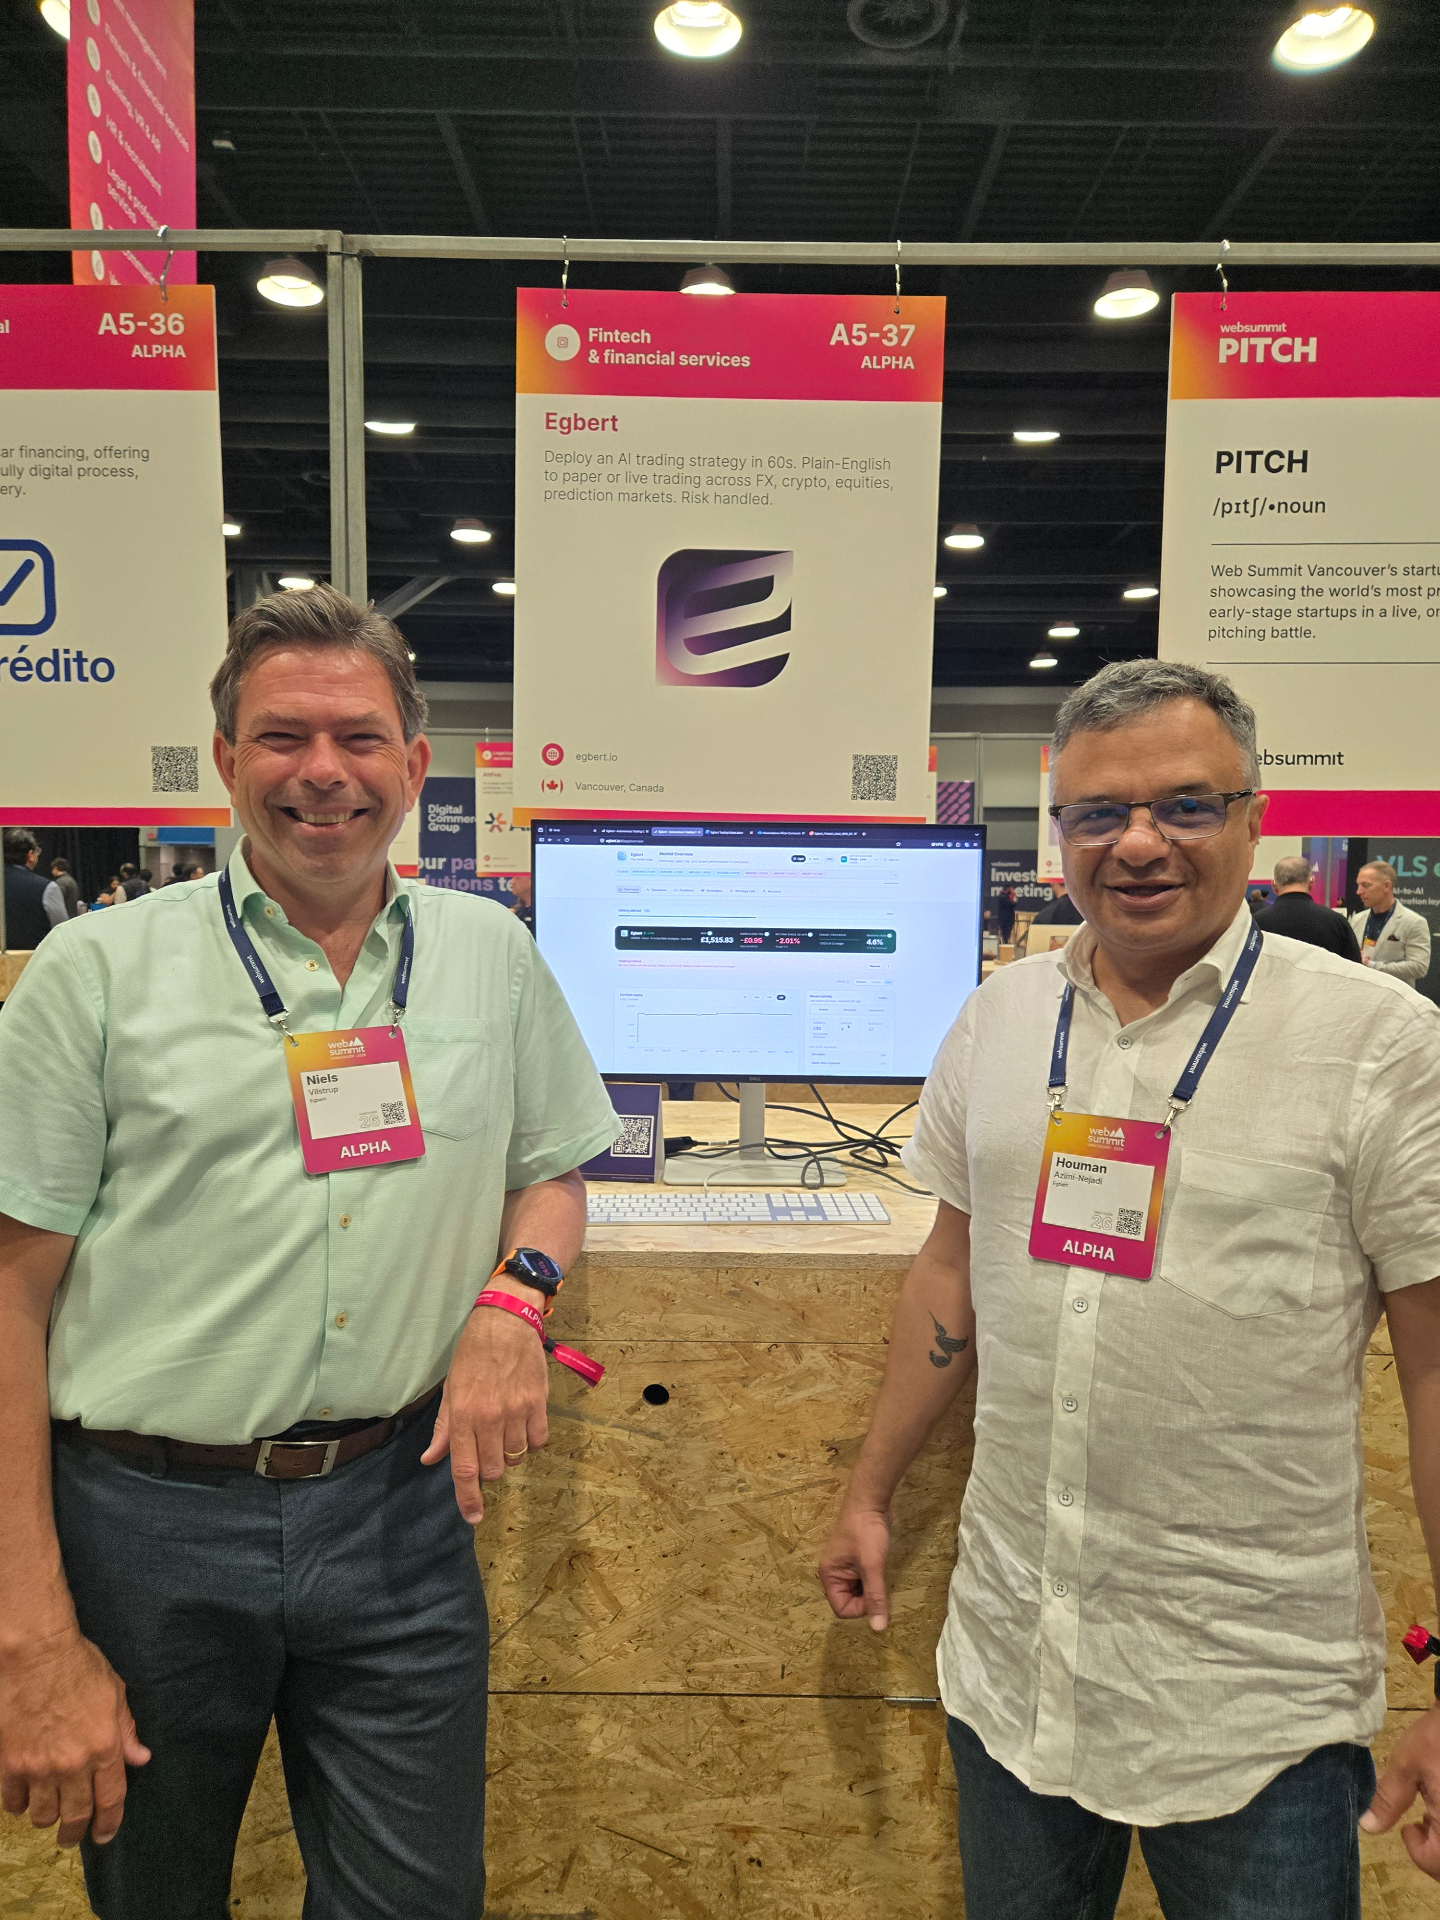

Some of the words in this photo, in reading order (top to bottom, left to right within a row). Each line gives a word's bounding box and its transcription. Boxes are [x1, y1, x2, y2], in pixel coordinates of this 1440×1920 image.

[98, 313, 185, 335] A5-36
[1220, 321, 1287, 333] websummit
[588, 327, 651, 344] Fintech
[829, 323, 916, 348] A5-37
[131, 345, 187, 358] ALPHA
[1218, 337, 1318, 364] PITCH
[588, 350, 599, 364] &
[603, 350, 676, 367] financial
[679, 352, 751, 368] services
[860, 355, 915, 370] ALPHA
[544, 412, 619, 435] Egbert
[19, 445, 89, 461] financing,
[93, 446, 150, 461] offering
[544, 450, 593, 468] Deploy
[597, 455, 613, 466] an
[618, 453, 631, 466] AI
[636, 452, 684, 470] trading
[689, 454, 747, 471] strategy
[751, 454, 763, 467] in
[767, 454, 797, 469] 60s.
[801, 455, 891, 474] Plain-English
[1215, 450, 1309, 474] PITCH
[29, 465, 73, 479] digital
[77, 466, 139, 480] process,
[544, 470, 558, 482] to
[562, 472, 602, 487] paper
[606, 474, 621, 484] or
[624, 472, 648, 485] live
[652, 472, 701, 488] trading
[705, 476, 752, 487] across
[756, 475, 778, 489] FX,
[782, 475, 830, 491] crypto,
[835, 475, 894, 492] equities,
[544, 489, 613, 504] prediction
[618, 490, 677, 504] markets.
[681, 491, 709, 504] Risk
[713, 491, 773, 506] handled.
[1211, 564, 1243, 577] Web
[1247, 563, 1303, 577] Summit
[1210, 584, 1296, 600] showcasing
[1301, 585, 1324, 597] the
[1386, 586, 1423, 597] most
[1209, 606, 1293, 621] early-stage
[1297, 606, 1357, 621] startups
[1362, 606, 1375, 618] in
[1379, 608, 1388, 618] a
[1392, 605, 1421, 620] live,
[1208, 626, 1266, 641] pitching
[1271, 626, 1316, 639] battle.
[575, 751, 618, 764] egbert.io
[1256, 749, 1345, 766] ebsummit
[575, 782, 627, 795] Vancouver,
[629, 782, 665, 794] Canada
[428, 804, 463, 815] Digital
[428, 823, 460, 834] Group
[451, 858, 476, 874] pa
[991, 883, 1053, 902] meting
[328, 1039, 349, 1049] web
[329, 1045, 366, 1057] summit
[307, 1073, 339, 1086] Niels
[309, 1087, 339, 1096] Vilstrup
[359, 1115, 381, 1129] 26
[1089, 1127, 1111, 1137] web
[1088, 1135, 1125, 1147] summit
[340, 1140, 391, 1159] ALPHA
[1056, 1157, 1107, 1174] Houman
[1054, 1172, 1103, 1186] Azimi-Nejadi
[1091, 1215, 1113, 1231] 26
[1062, 1240, 1116, 1262] ALPHA
[521, 1306, 543, 1333] ALPHA
